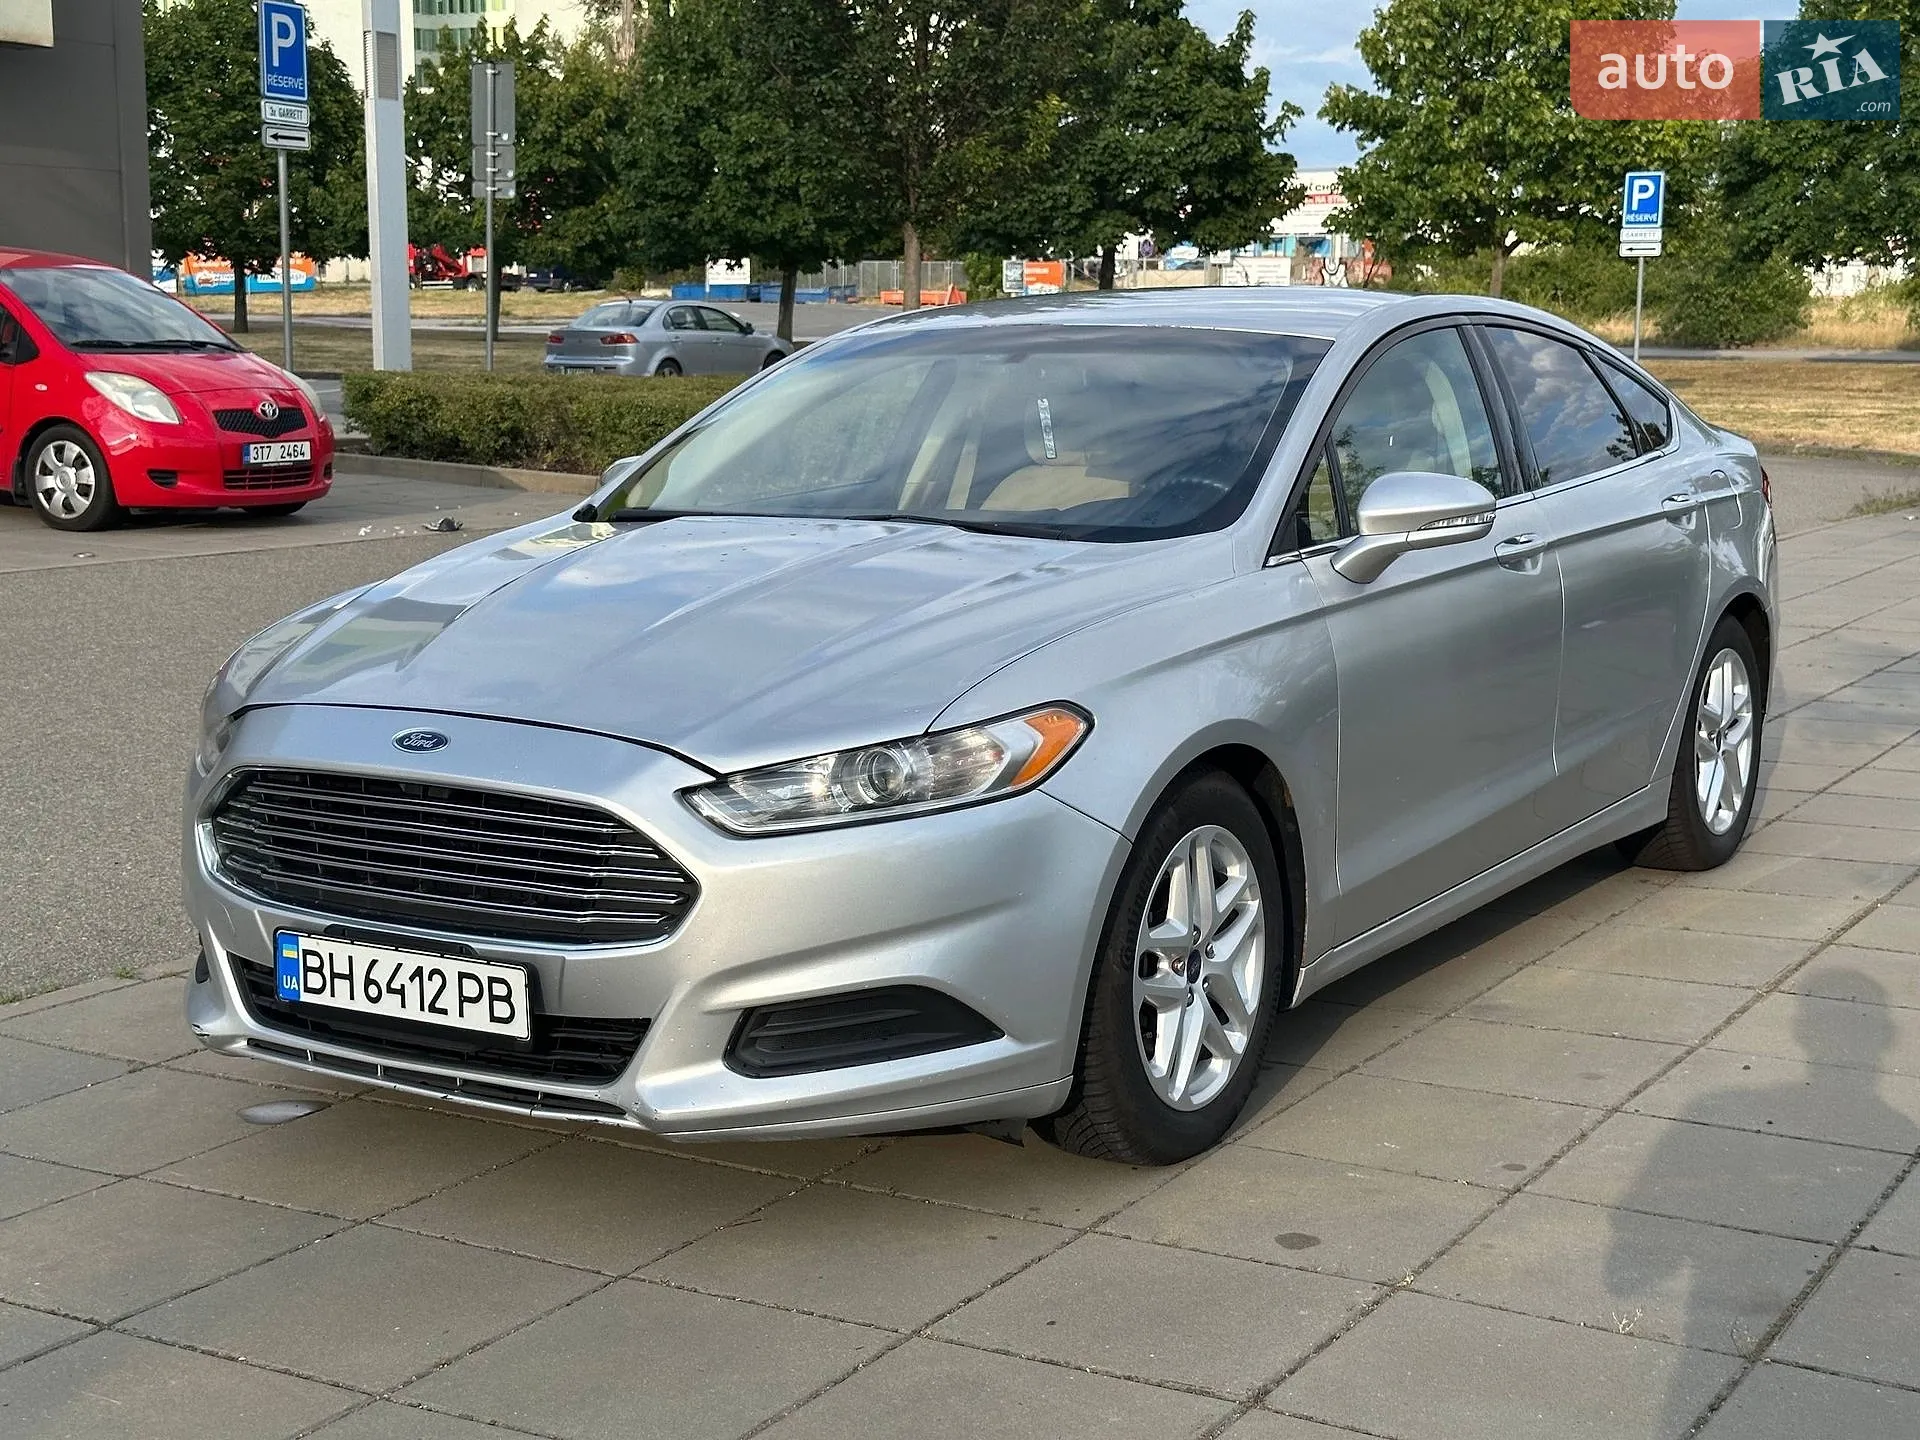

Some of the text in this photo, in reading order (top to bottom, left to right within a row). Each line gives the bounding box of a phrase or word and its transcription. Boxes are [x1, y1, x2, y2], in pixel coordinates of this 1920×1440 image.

[271, 12, 296, 67] P
[278, 107, 304, 121] GARRETT
[1631, 178, 1656, 211] P
[1625, 231, 1657, 240] GARRETT
[253, 445, 272, 461] 3T7
[280, 443, 305, 459] 2464
[403, 732, 438, 748] Ford
[283, 974, 299, 991] UA
[302, 948, 516, 1025] BH 6412 PB
